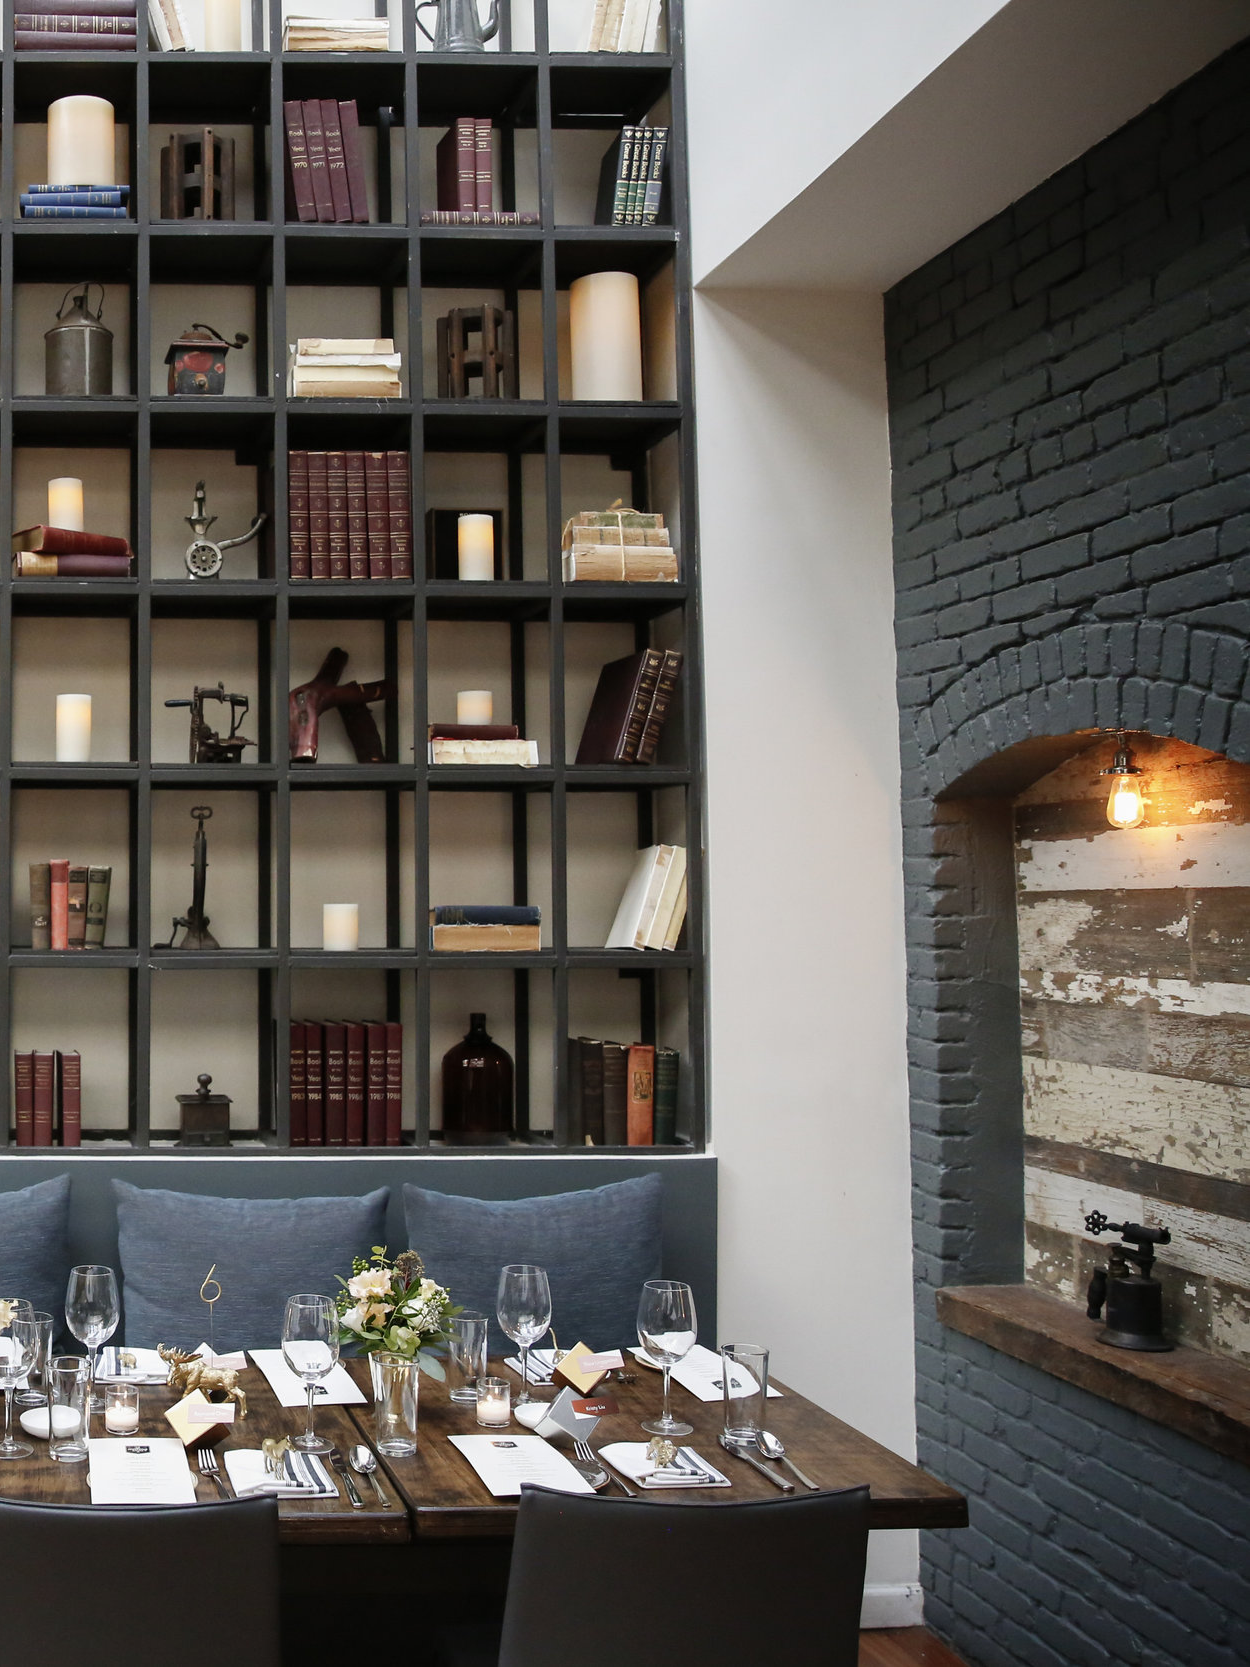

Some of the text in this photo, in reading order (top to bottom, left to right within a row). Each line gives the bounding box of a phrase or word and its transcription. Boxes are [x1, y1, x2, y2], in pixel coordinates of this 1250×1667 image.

[288, 129, 304, 137] Book
[308, 129, 322, 137] Book
[325, 129, 341, 137] Book
[623, 143, 632, 160] Great
[642, 144, 651, 161] Great
[293, 161, 308, 169] 1970
[312, 161, 326, 169] 1971
[330, 161, 345, 169] 1972
[621, 160, 630, 179] Books
[631, 144, 641, 179] Great Books
[640, 161, 649, 179] Books
[652, 144, 663, 179] Great Books
[200, 1263, 221, 1303] 6
